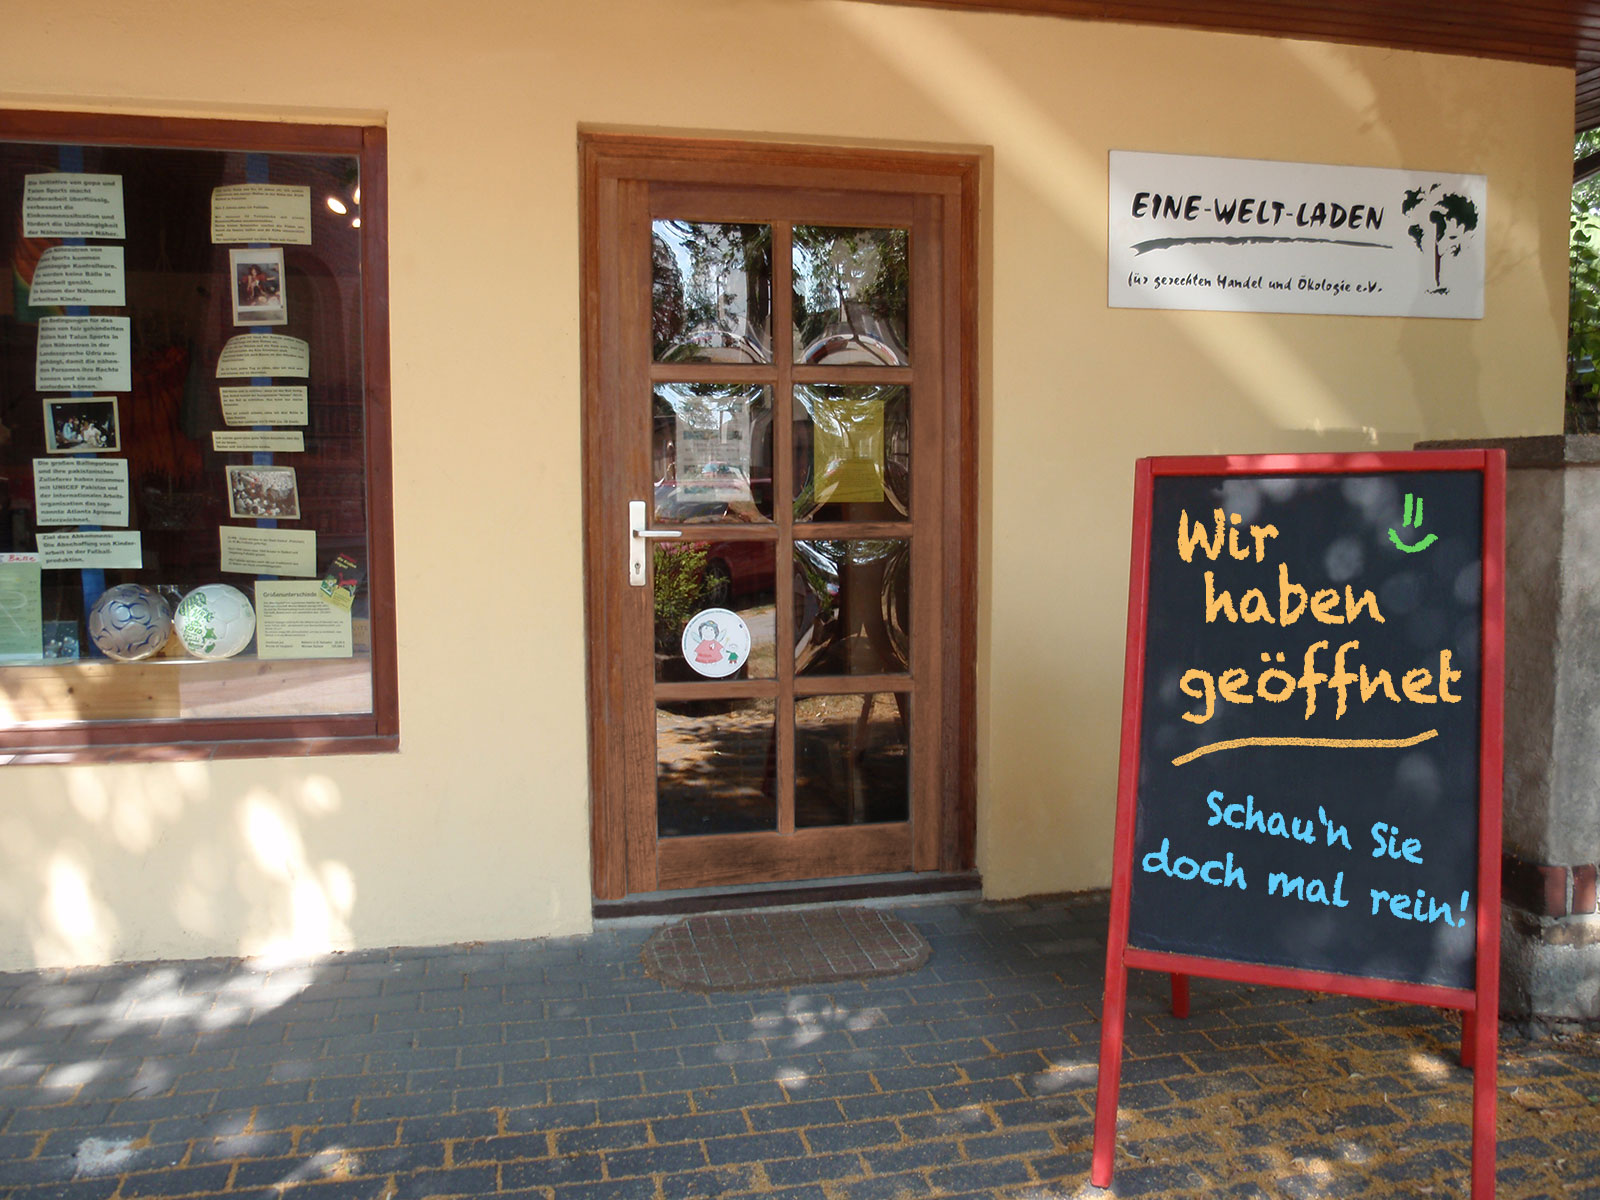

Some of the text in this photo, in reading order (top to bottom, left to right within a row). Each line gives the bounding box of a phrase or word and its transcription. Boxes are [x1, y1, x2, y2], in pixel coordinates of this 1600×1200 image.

[1131, 192, 1386, 231] EINE-WELT-LADEN
[1154, 273, 1212, 290] gerechten
[1217, 274, 1263, 290] Handel
[1268, 277, 1292, 292] und
[1297, 274, 1352, 296] Ökologie
[1356, 279, 1383, 293] e.V.
[1177, 508, 1279, 563] Wir
[1204, 562, 1386, 627] haben
[1179, 639, 1462, 725] geöffnet
[1206, 790, 1424, 865] Schau'n Sie
[1142, 838, 1471, 929] doch mal rein!
